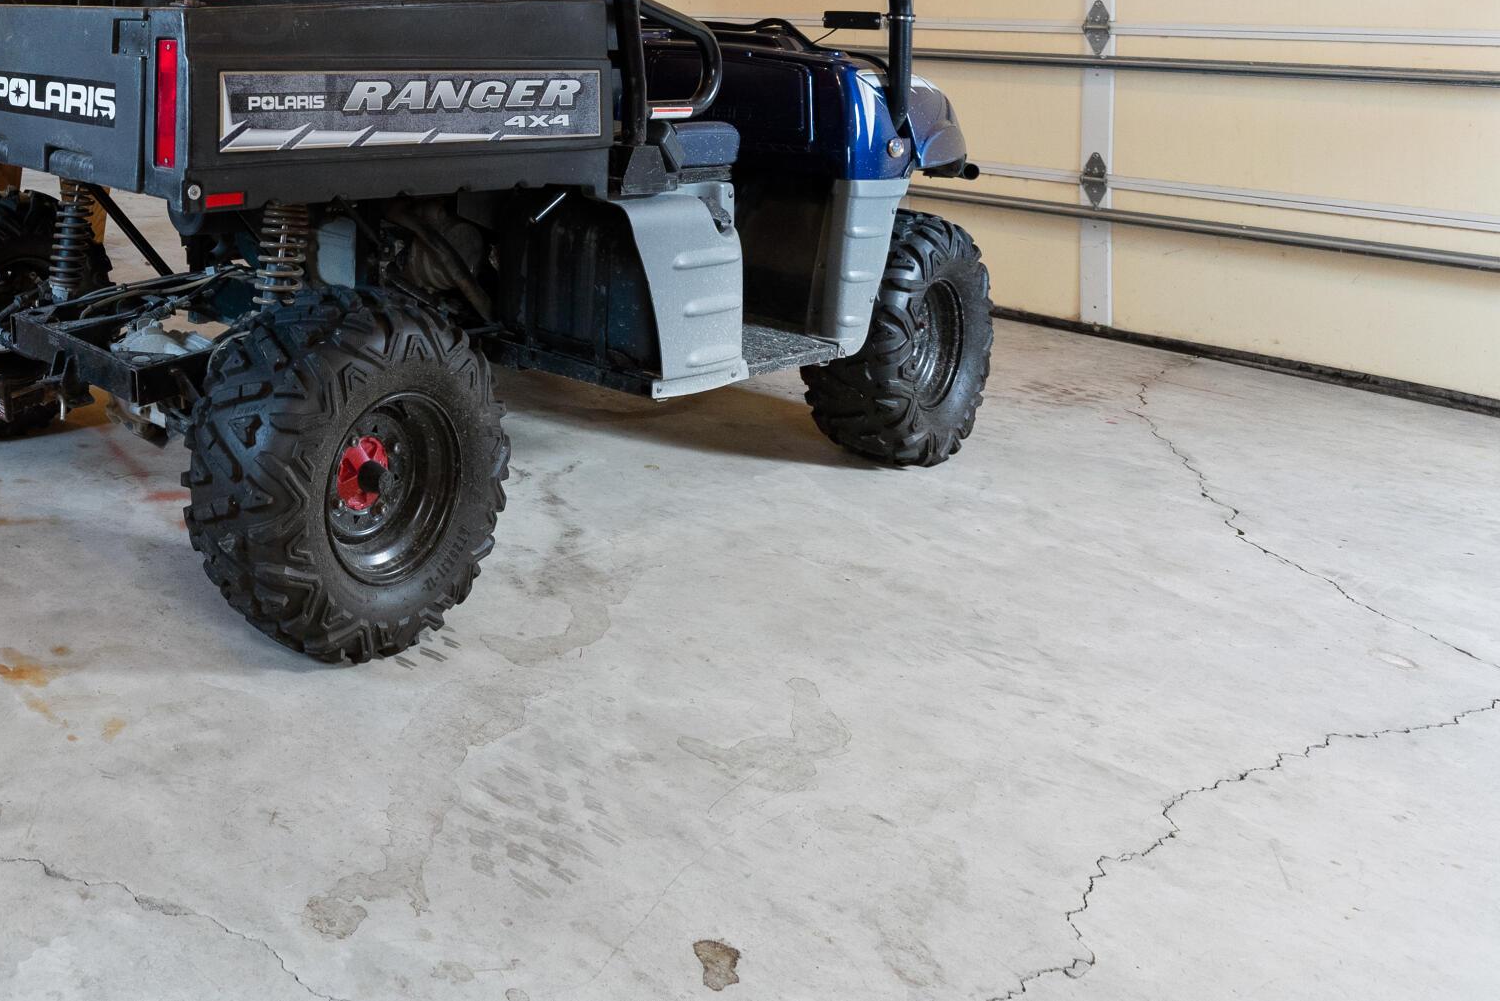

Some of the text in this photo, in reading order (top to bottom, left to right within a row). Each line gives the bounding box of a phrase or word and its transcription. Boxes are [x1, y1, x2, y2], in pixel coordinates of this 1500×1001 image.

[247, 79, 582, 111] POLARIS RANGER
[503, 114, 571, 129] 4X4
